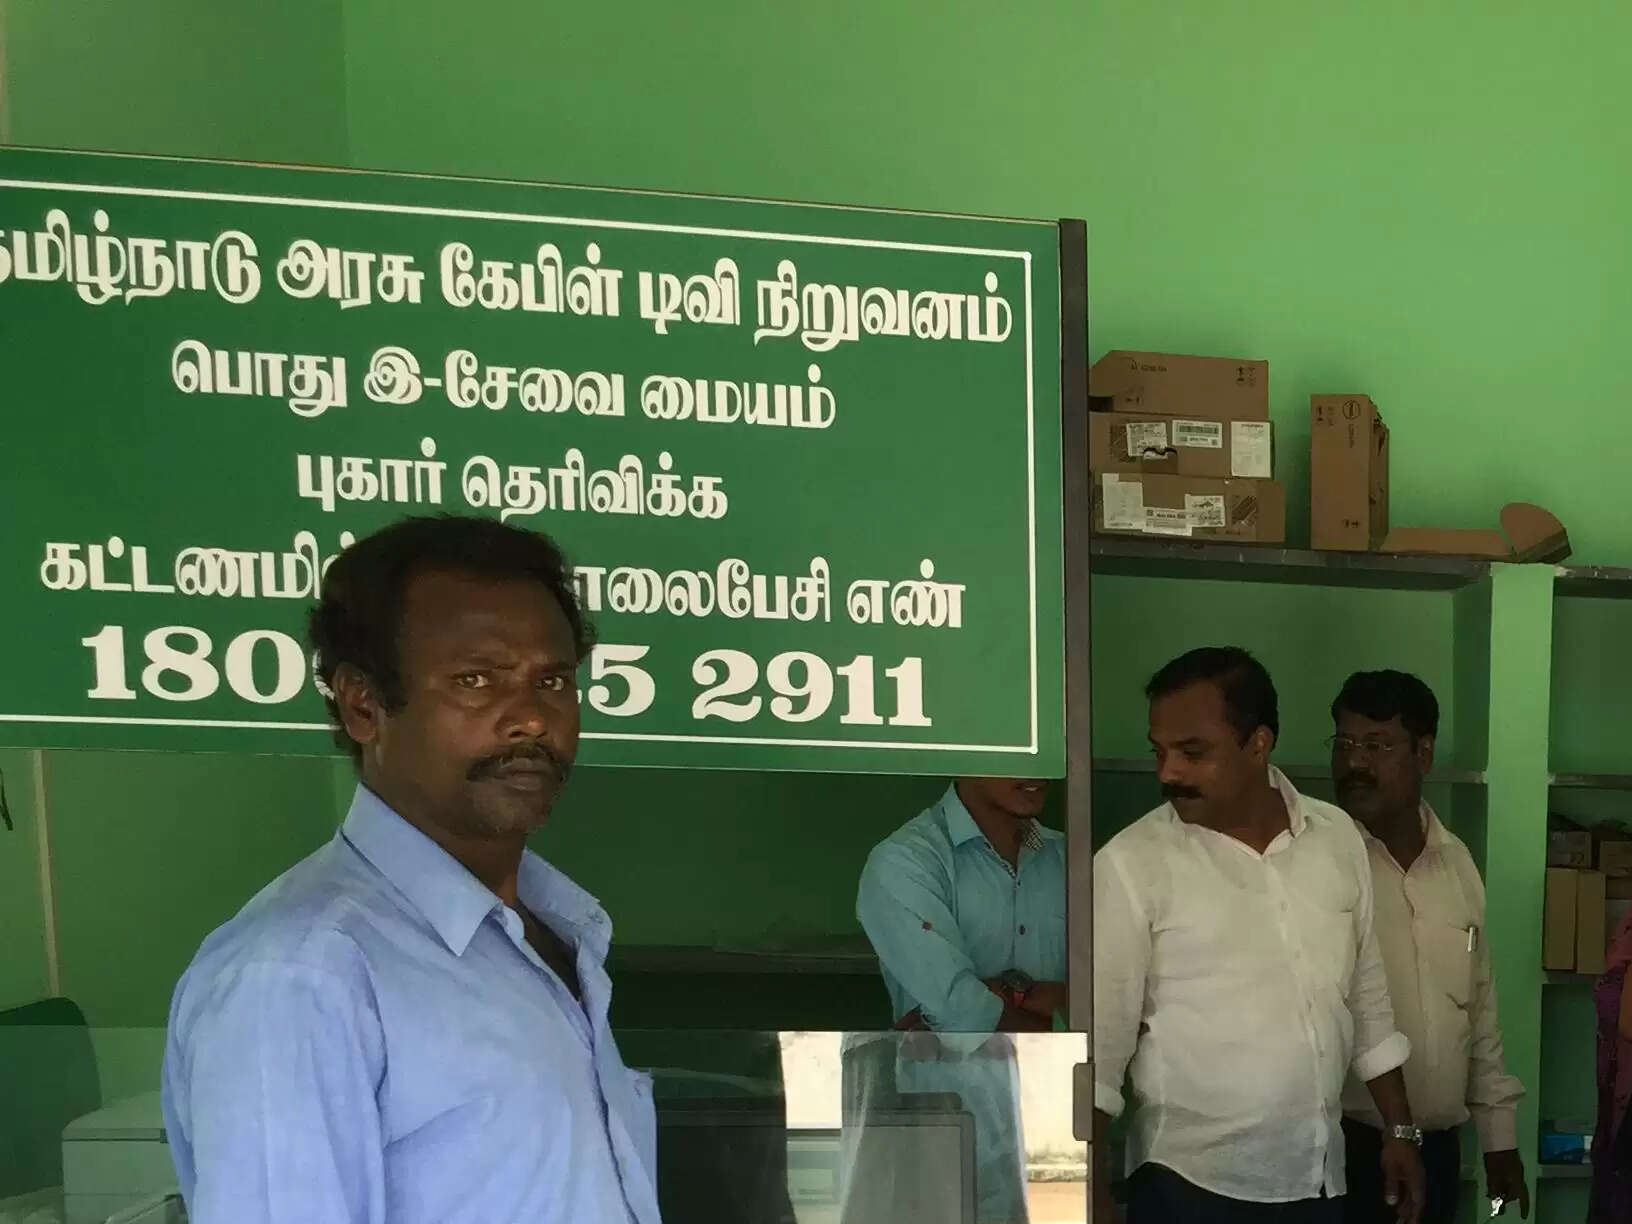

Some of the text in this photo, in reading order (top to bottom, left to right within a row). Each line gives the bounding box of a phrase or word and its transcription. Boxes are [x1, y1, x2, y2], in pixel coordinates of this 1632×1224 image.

[0, 209, 1012, 351] மிழ்நாடு அரசு கேபிள் டிவி நிறுவனம்
[172, 341, 835, 428] பொது இ-சேவை மையம்
[298, 437, 727, 523] புகார் தெரிவிக்க
[41, 531, 356, 599] கட்டணமி
[847, 563, 965, 627] எண்
[82, 626, 334, 704] 180
[692, 650, 931, 726] 2911
